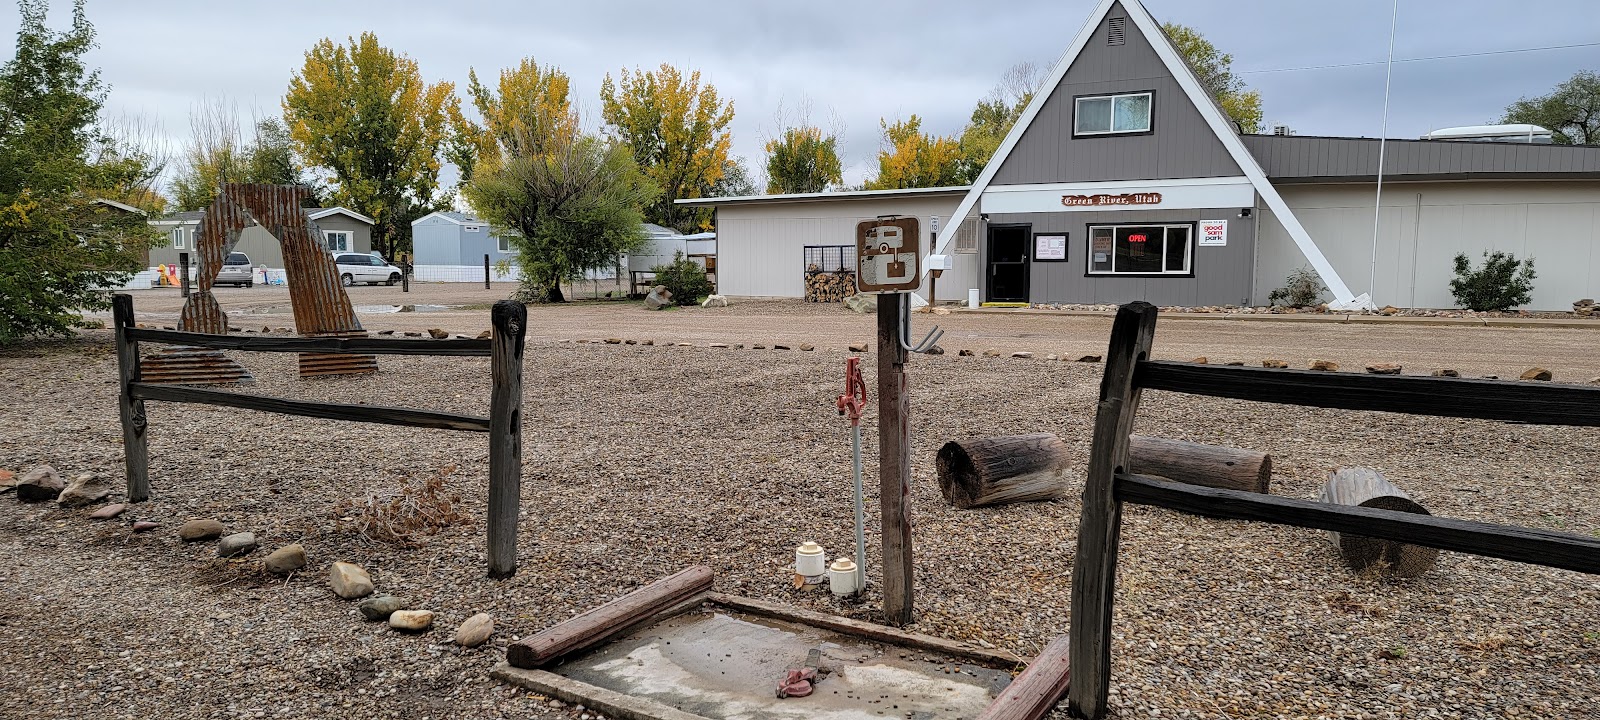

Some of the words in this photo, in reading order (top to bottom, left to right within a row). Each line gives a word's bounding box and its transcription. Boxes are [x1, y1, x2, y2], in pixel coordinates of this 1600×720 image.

[1064, 195, 1093, 205] Green
[1098, 195, 1129, 205] River,
[1135, 194, 1159, 203] Utah
[1203, 224, 1223, 232] good
[1128, 234, 1147, 242] OPEN
